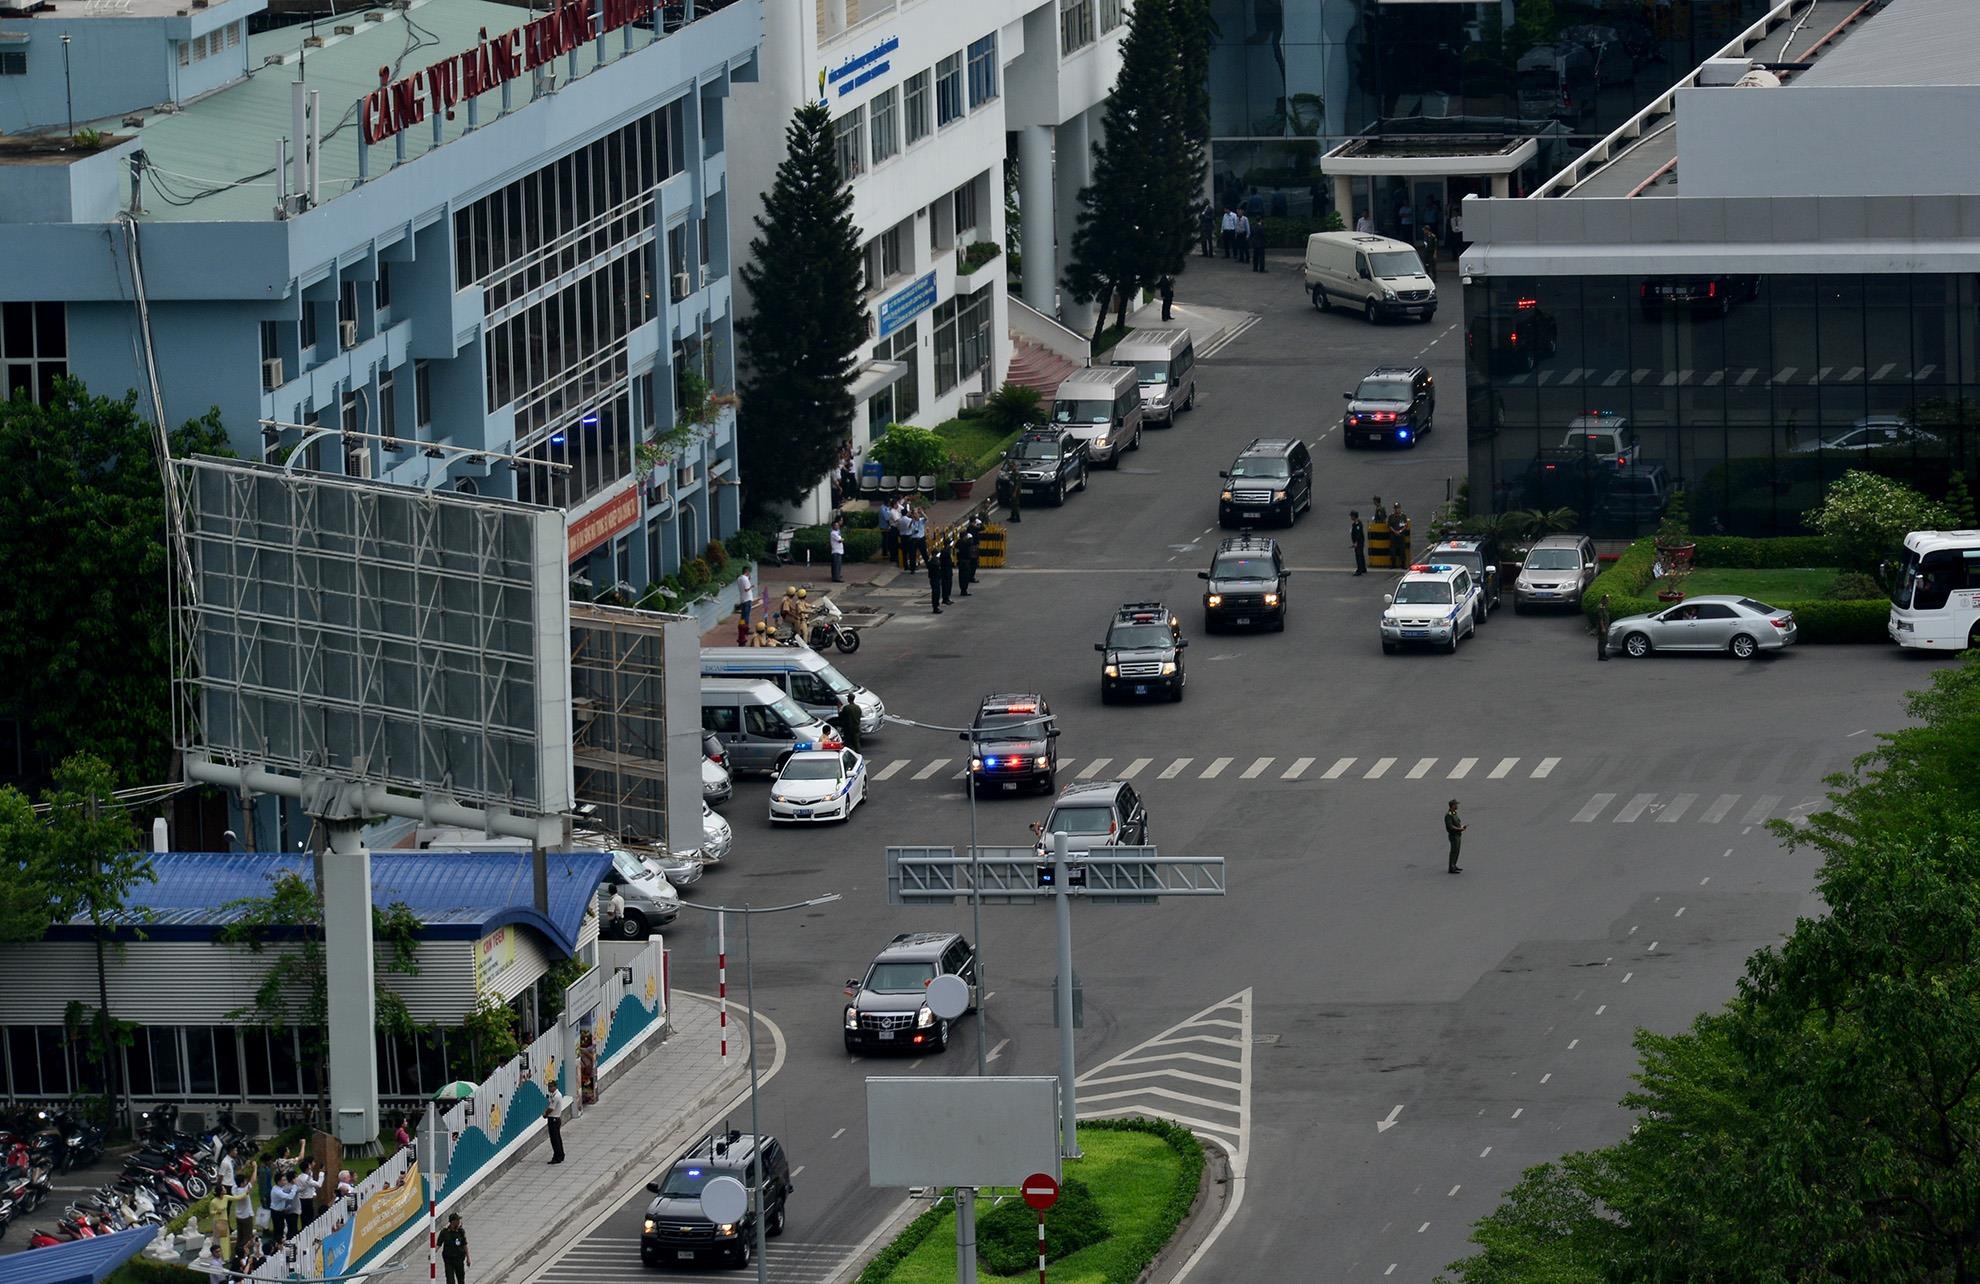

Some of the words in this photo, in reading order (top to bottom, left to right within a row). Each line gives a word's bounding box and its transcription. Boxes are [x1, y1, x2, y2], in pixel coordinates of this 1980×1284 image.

[363, 66, 425, 145] CẢNG
[426, 56, 458, 120] VỤ
[461, 26, 522, 102] HÀNG
